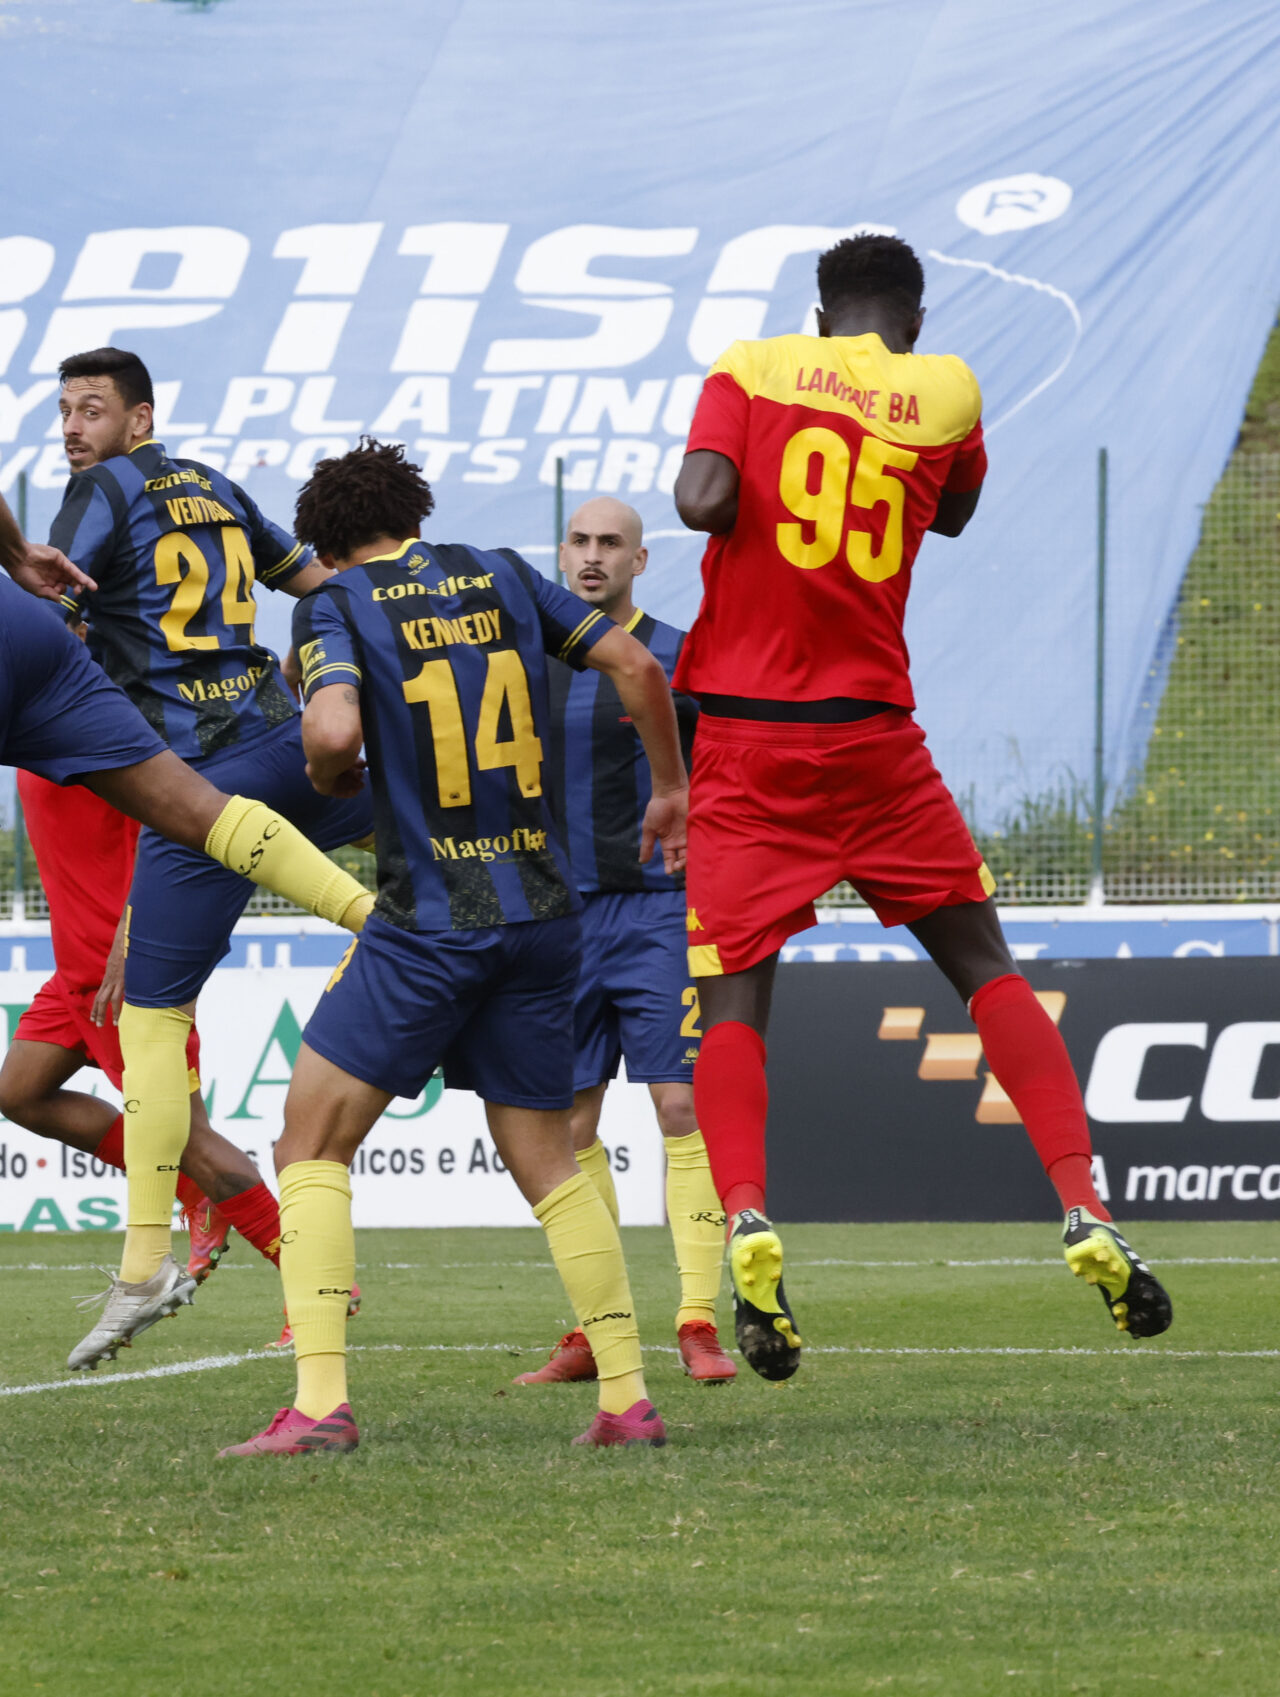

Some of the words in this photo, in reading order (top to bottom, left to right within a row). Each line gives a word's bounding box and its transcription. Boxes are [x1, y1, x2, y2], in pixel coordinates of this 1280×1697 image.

[888, 392, 920, 425] BA
[778, 426, 919, 582] 95
[154, 526, 256, 653] 24
[400, 608, 502, 650] KENNEDY
[402, 649, 543, 809] 14
[438, 1148, 456, 1174] e
